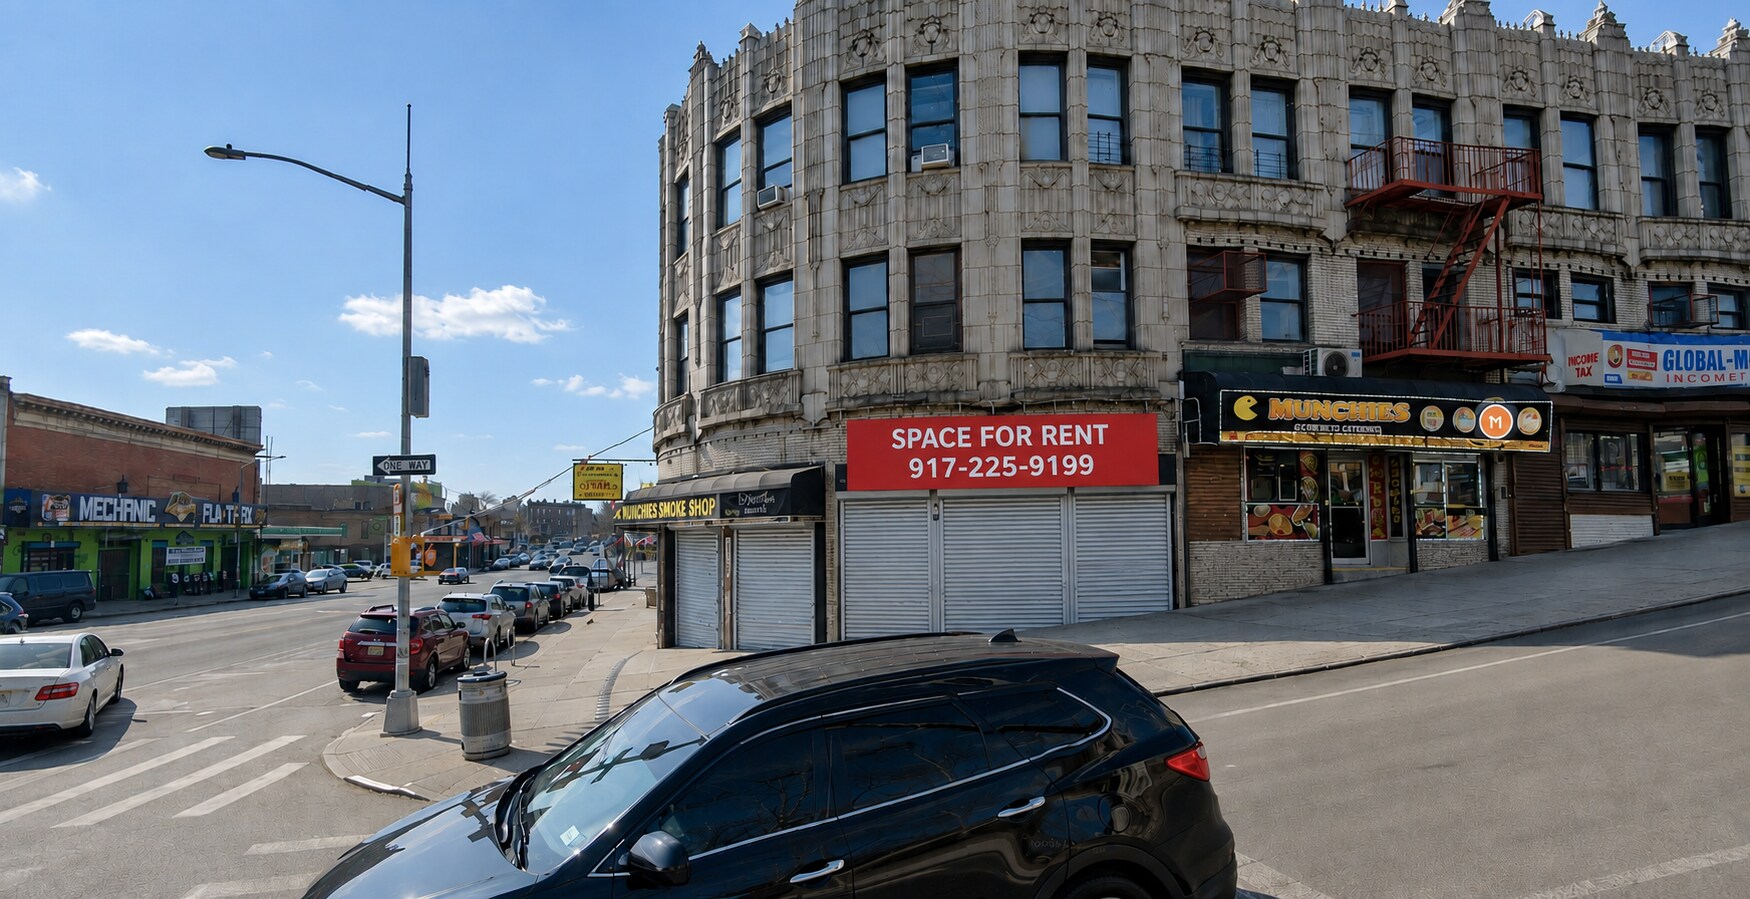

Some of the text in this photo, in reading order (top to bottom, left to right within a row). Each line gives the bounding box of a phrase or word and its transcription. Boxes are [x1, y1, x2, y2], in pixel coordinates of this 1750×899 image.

[1575, 366, 1592, 378] TAX
[1663, 349, 1750, 372] GLOBAL-M
[1268, 397, 1411, 423] MUNCHIES
[892, 424, 1108, 449] SPACE FOR RENT
[383, 460, 428, 470] ONE WAY
[909, 454, 1093, 478] 917-225-9199
[658, 500, 687, 518] SMOKE
[688, 497, 716, 517] SHOP
